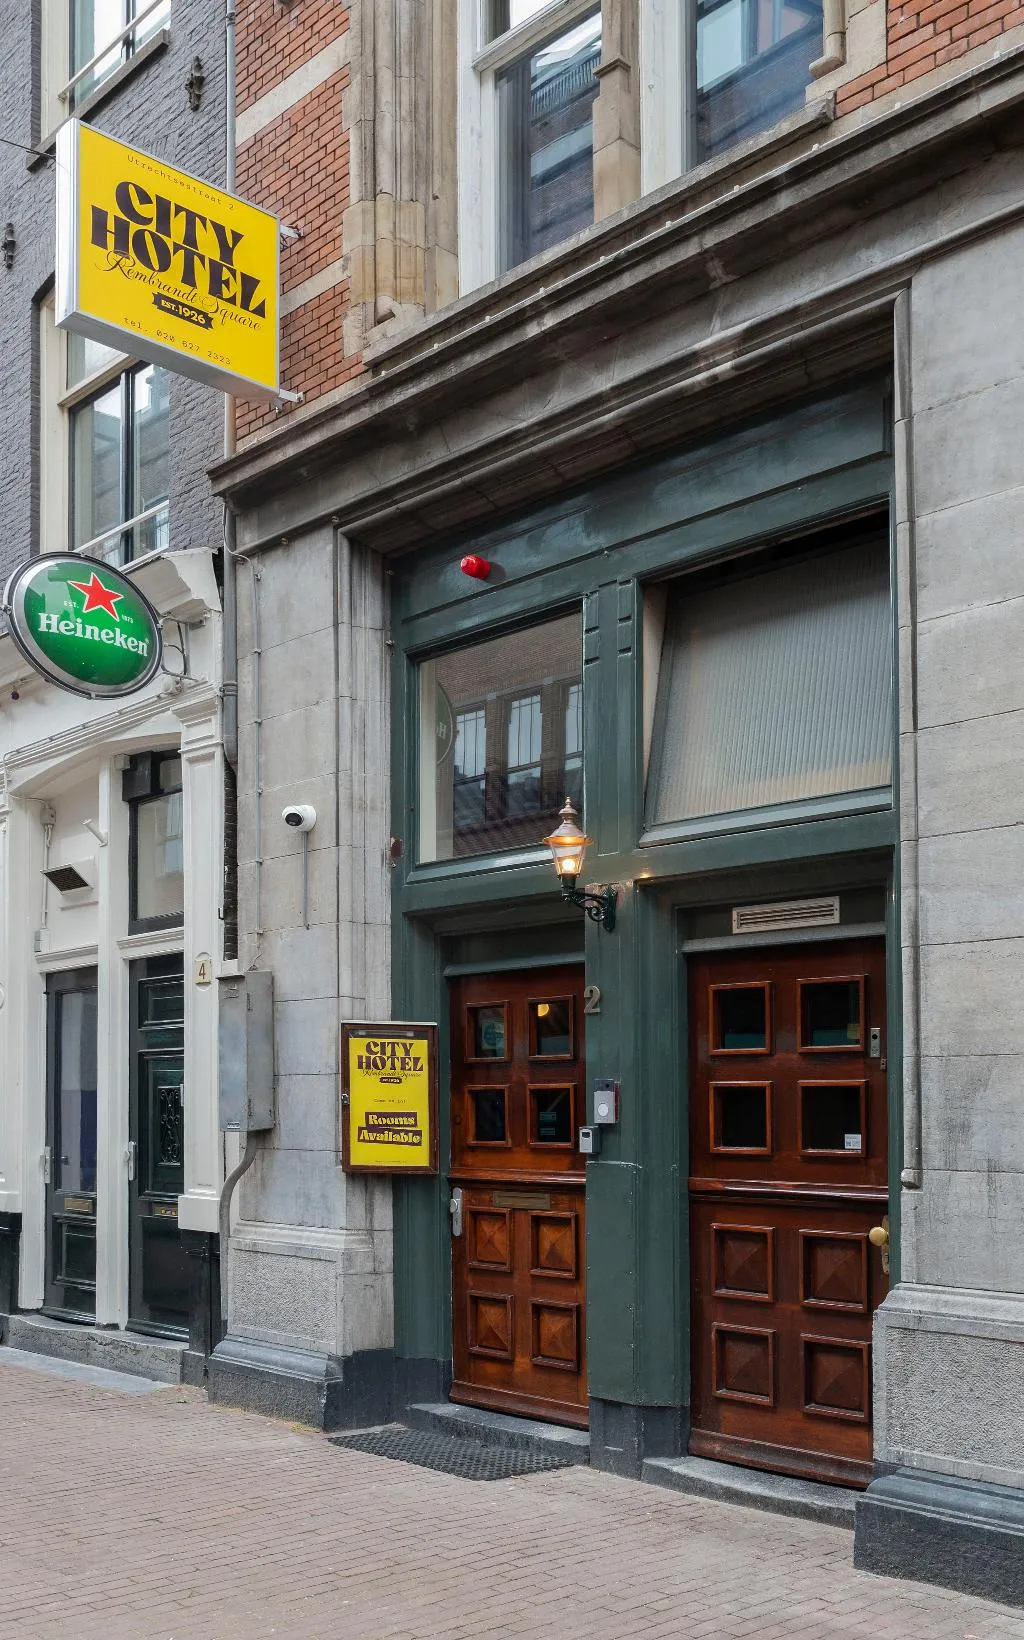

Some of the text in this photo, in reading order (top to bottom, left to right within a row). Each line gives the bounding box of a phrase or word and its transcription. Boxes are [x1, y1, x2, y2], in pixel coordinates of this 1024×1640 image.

[127, 154, 234, 211] Utrechtsestraat 2
[115, 181, 245, 267] CITY
[91, 204, 266, 318] HOTEL
[95, 250, 262, 329] Rembrandt Square
[123, 317, 231, 365] tel. 020 627 2323
[37, 612, 148, 657] Heineken
[198, 963, 206, 979] 4
[583, 985, 601, 1014] 2
[357, 1055, 424, 1071] HOTEL
[365, 1041, 414, 1056] CITY
[359, 1129, 421, 1143] Available
[368, 1114, 415, 1125] Rooms
